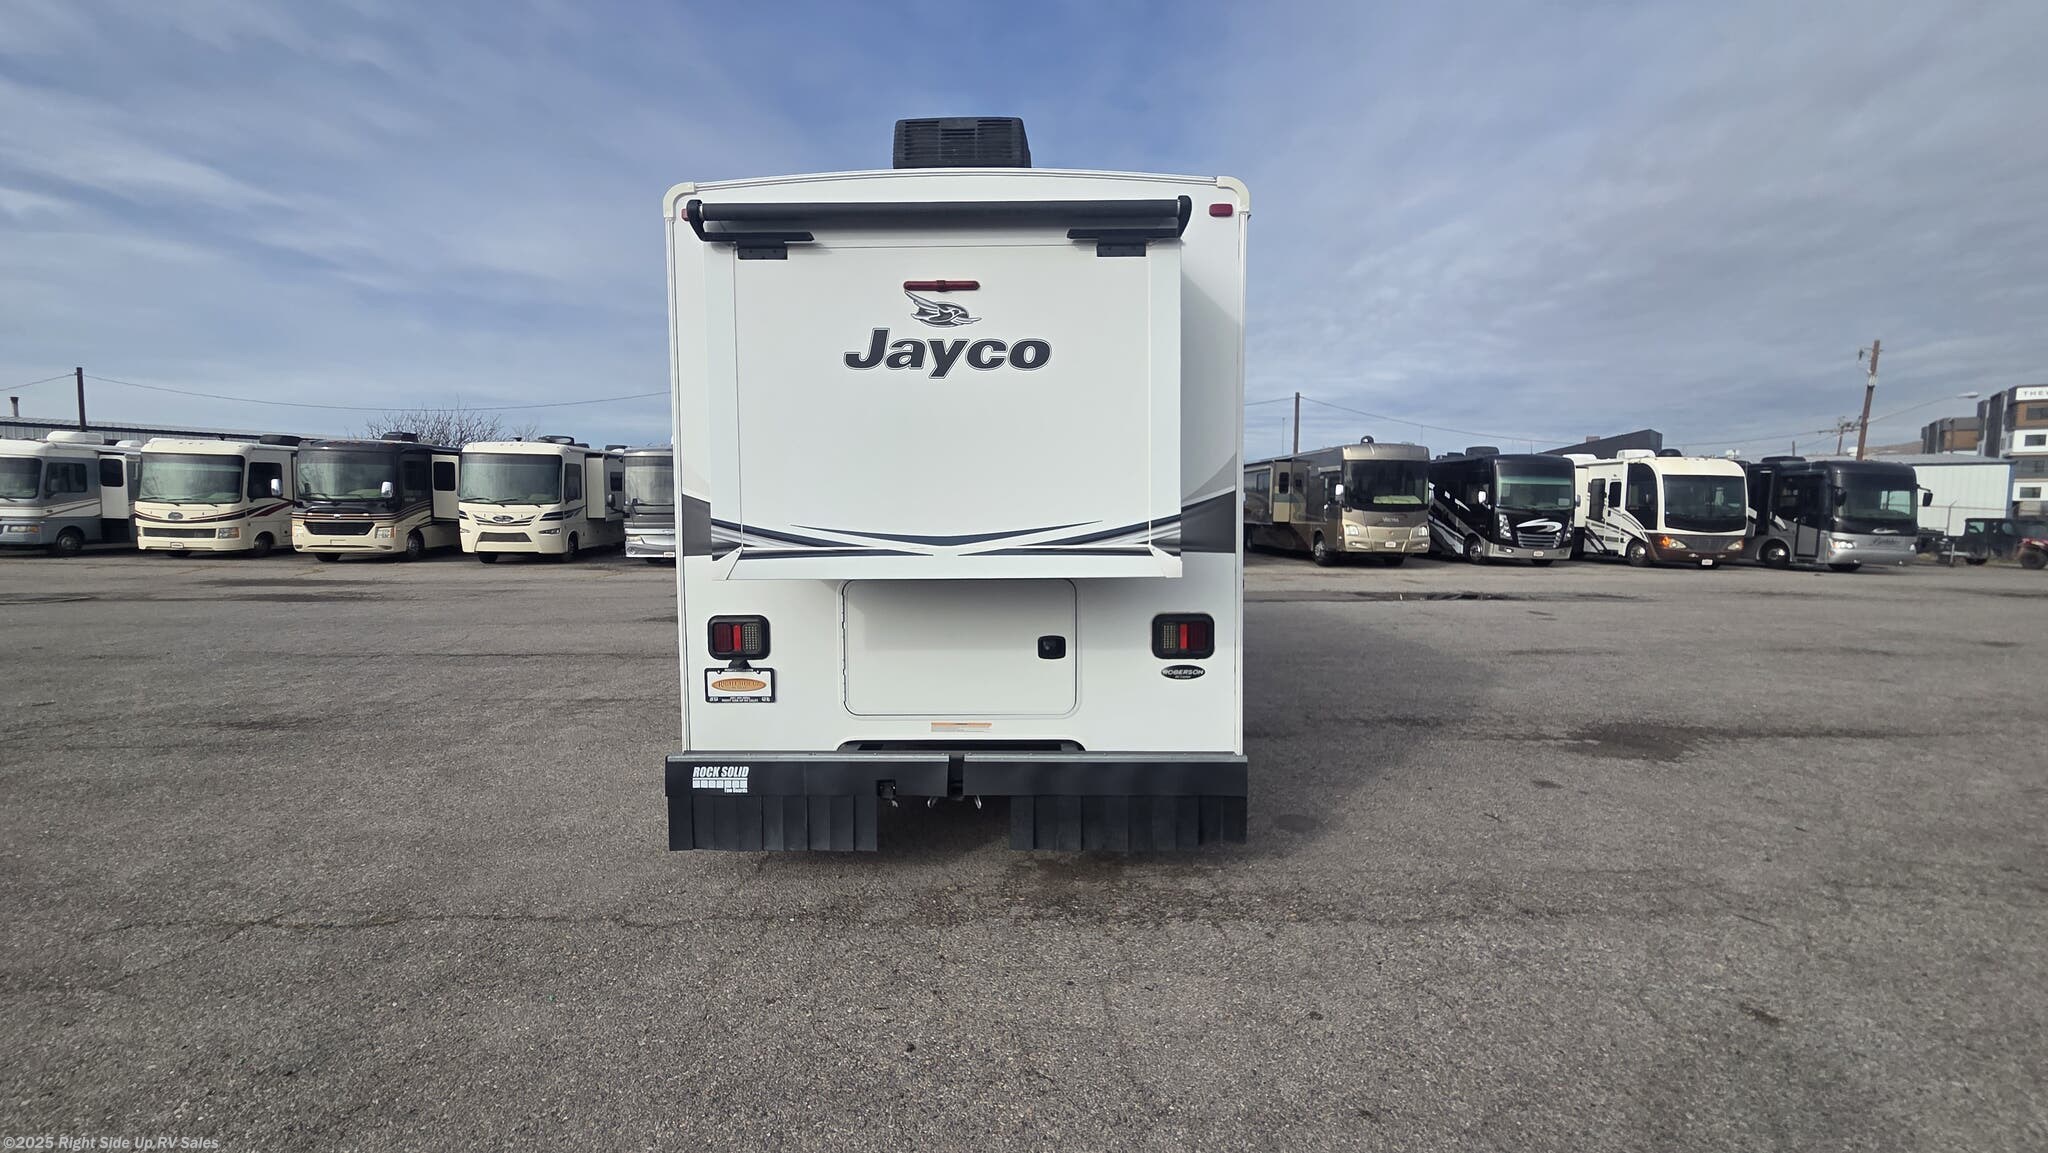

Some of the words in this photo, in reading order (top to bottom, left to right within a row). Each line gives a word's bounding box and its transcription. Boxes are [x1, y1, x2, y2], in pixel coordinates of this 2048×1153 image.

[843, 327, 1052, 379] Jayco
[692, 766, 721, 778] ROCK
[720, 766, 750, 778] SOLID
